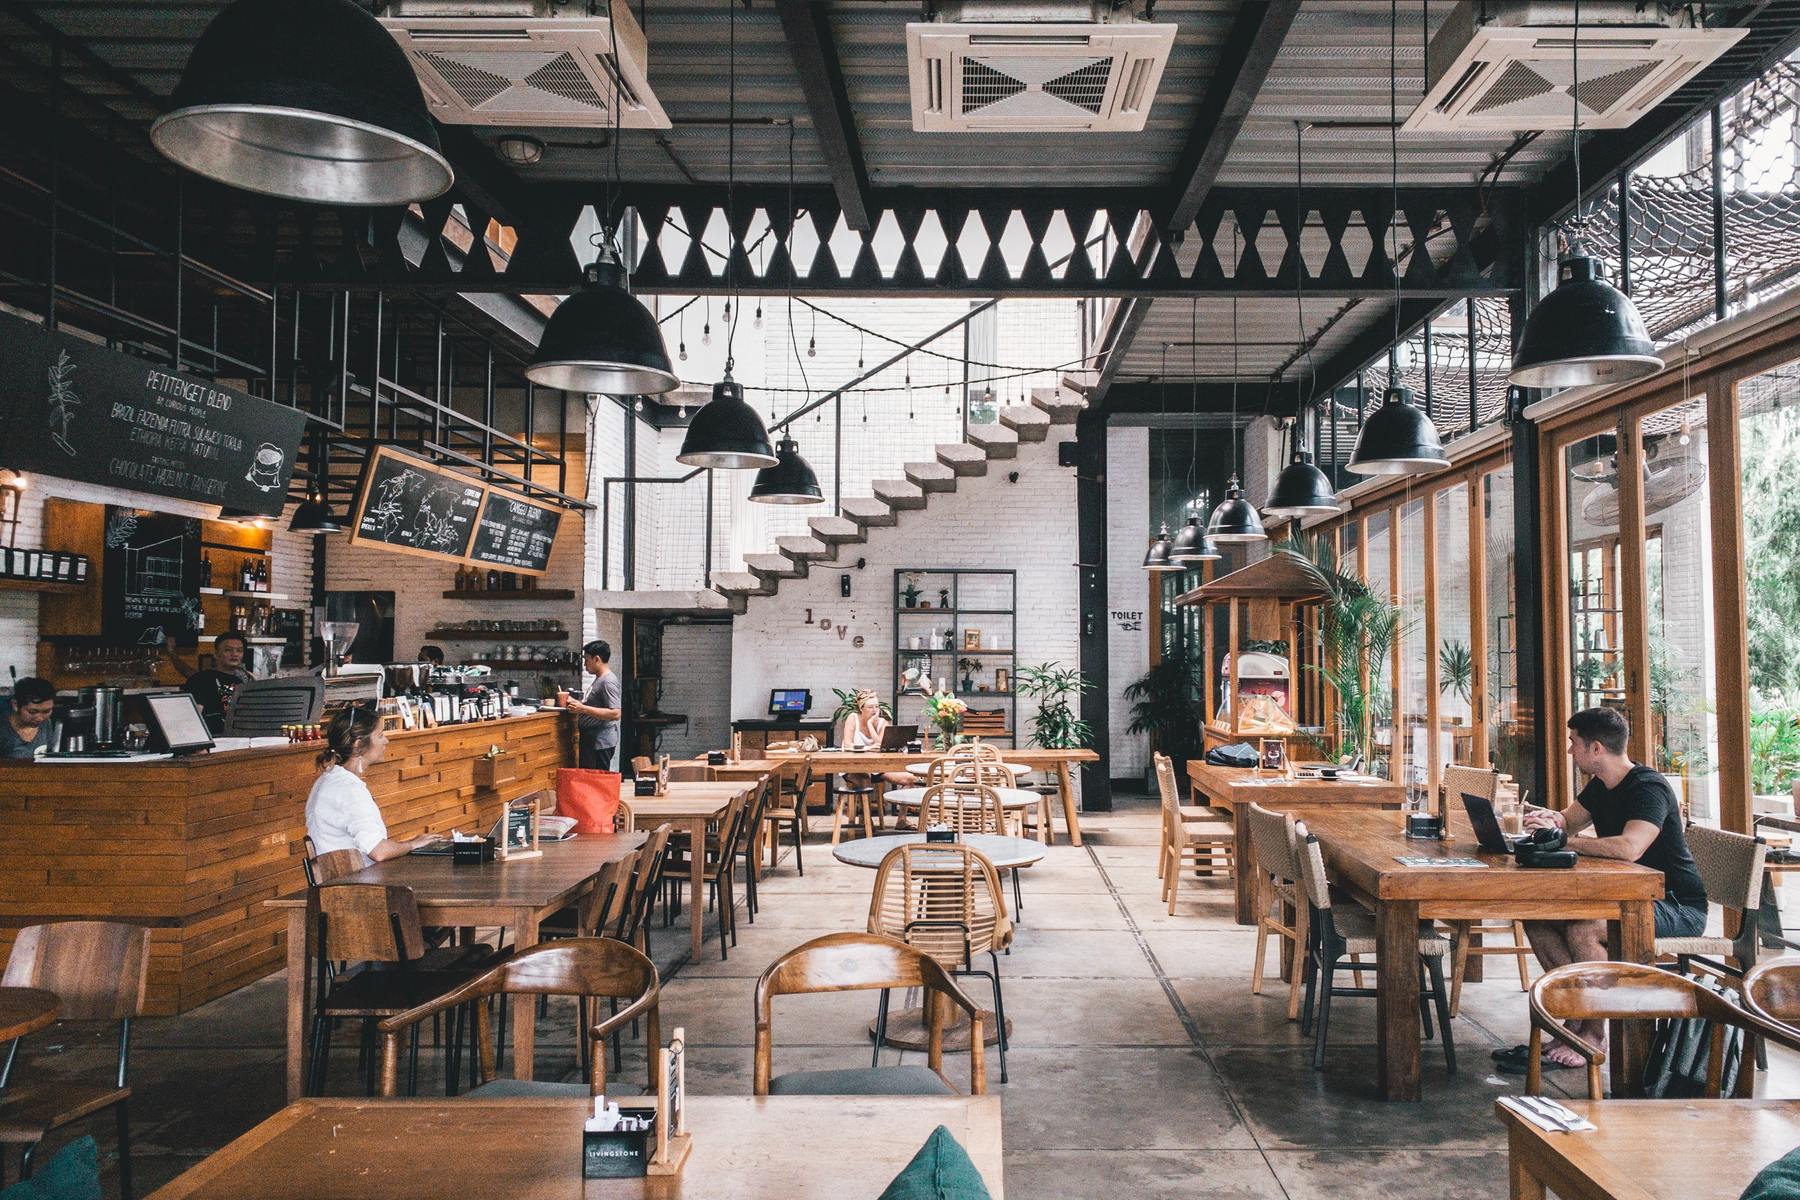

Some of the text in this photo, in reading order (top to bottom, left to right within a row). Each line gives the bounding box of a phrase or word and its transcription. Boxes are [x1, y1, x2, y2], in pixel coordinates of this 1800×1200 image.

[146, 370, 232, 411] PETITENGET BLEND
[188, 405, 206, 419] PEOPLE
[805, 608, 864, 648] love
[1111, 611, 1143, 620] TOILET
